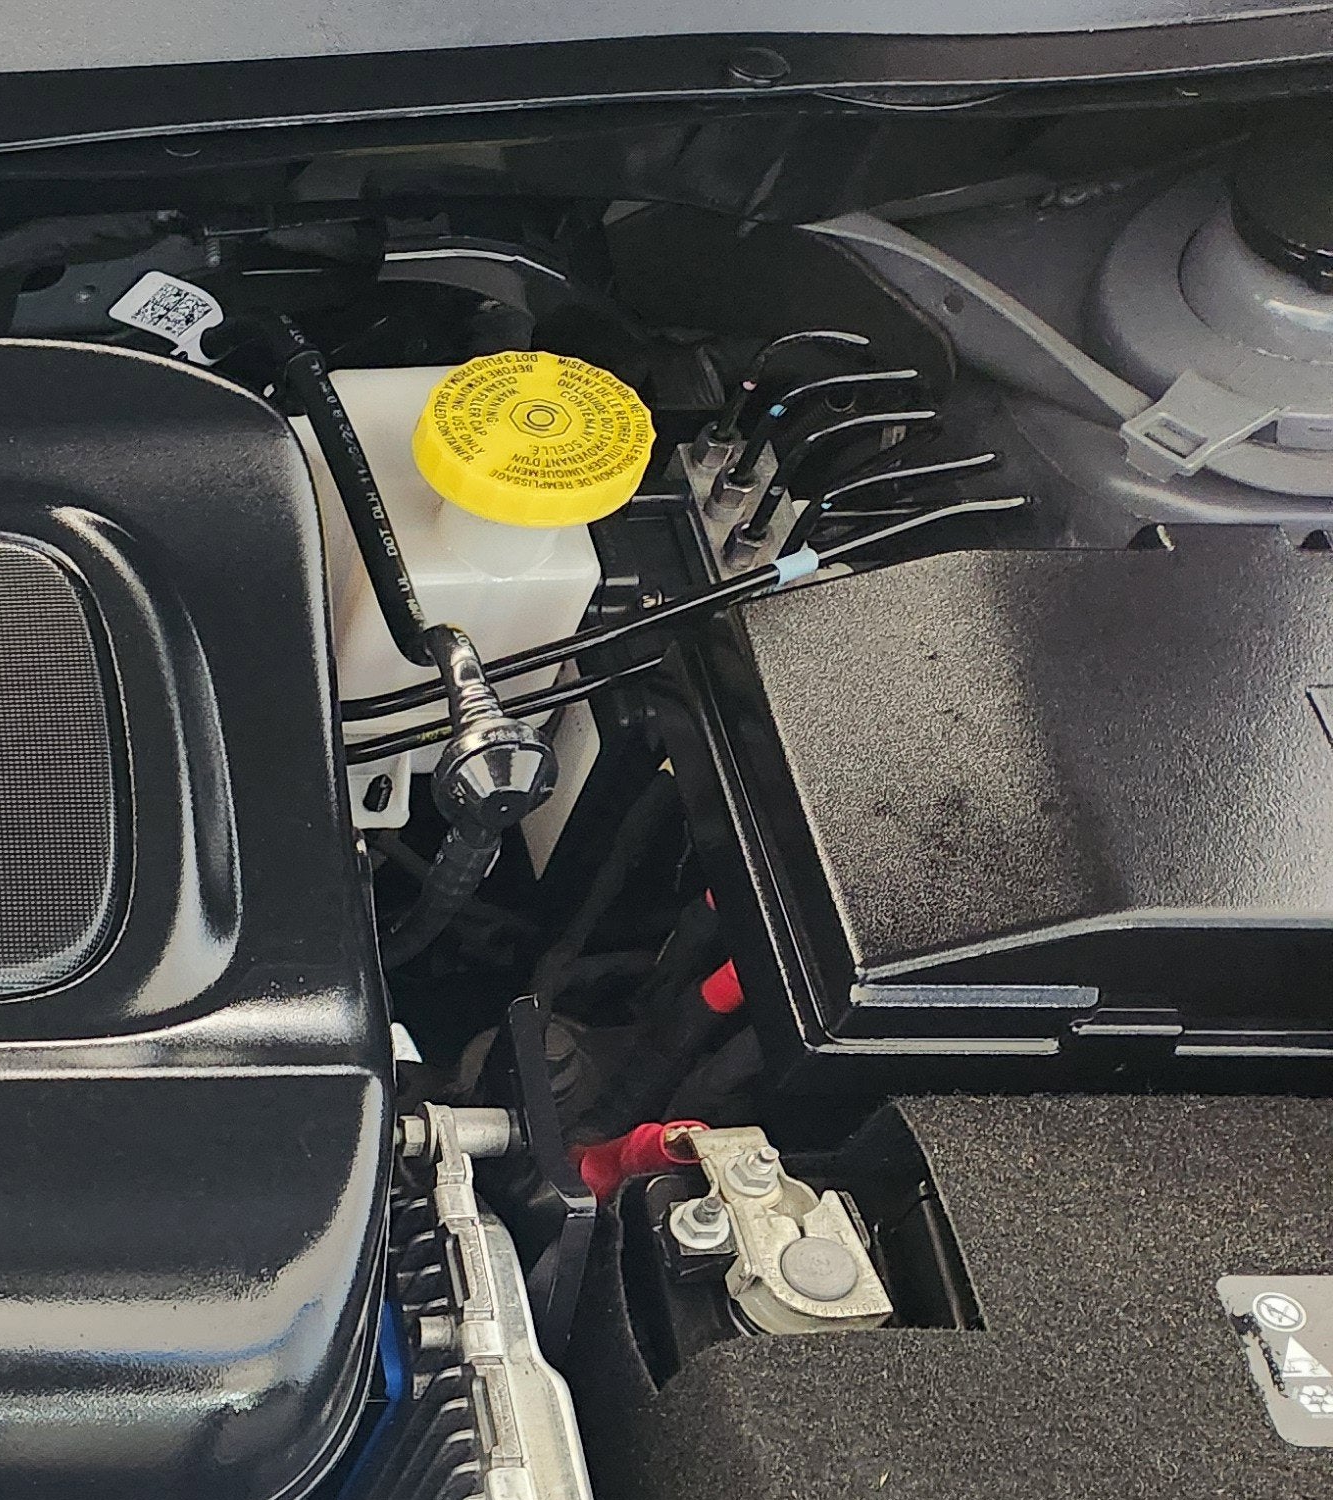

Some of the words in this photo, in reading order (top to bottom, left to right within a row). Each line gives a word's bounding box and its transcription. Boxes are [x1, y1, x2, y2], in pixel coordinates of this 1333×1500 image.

[472, 356, 504, 371] FLUID
[503, 353, 513, 363] 3
[515, 353, 538, 363] DOT
[557, 356, 586, 371] MISE
[448, 368, 476, 386] FROM
[489, 364, 534, 379] BEFORE
[560, 369, 599, 389] AVANT
[585, 365, 602, 378] EN
[442, 382, 455, 391] A
[483, 375, 518, 394] CLEAN
[573, 386, 610, 415] LIQUIDE
[594, 387, 612, 400] DE
[433, 390, 452, 419] SEALED
[469, 391, 488, 418] FILLER
[607, 399, 622, 412] LE
[451, 415, 468, 431] USE
[559, 390, 596, 444] CONTENANT
[600, 416, 615, 434] DOT
[469, 420, 488, 436] CAP
[459, 433, 486, 455] ONLY
[599, 433, 613, 441] 3
[544, 440, 610, 468] PROVENANT
[504, 464, 585, 480] UNIQUEMENT
[593, 453, 639, 482] BOUCHON
[488, 468, 575, 490] REMPLISSAGE
[577, 476, 593, 488] DE
[379, 528, 398, 558] DOT
